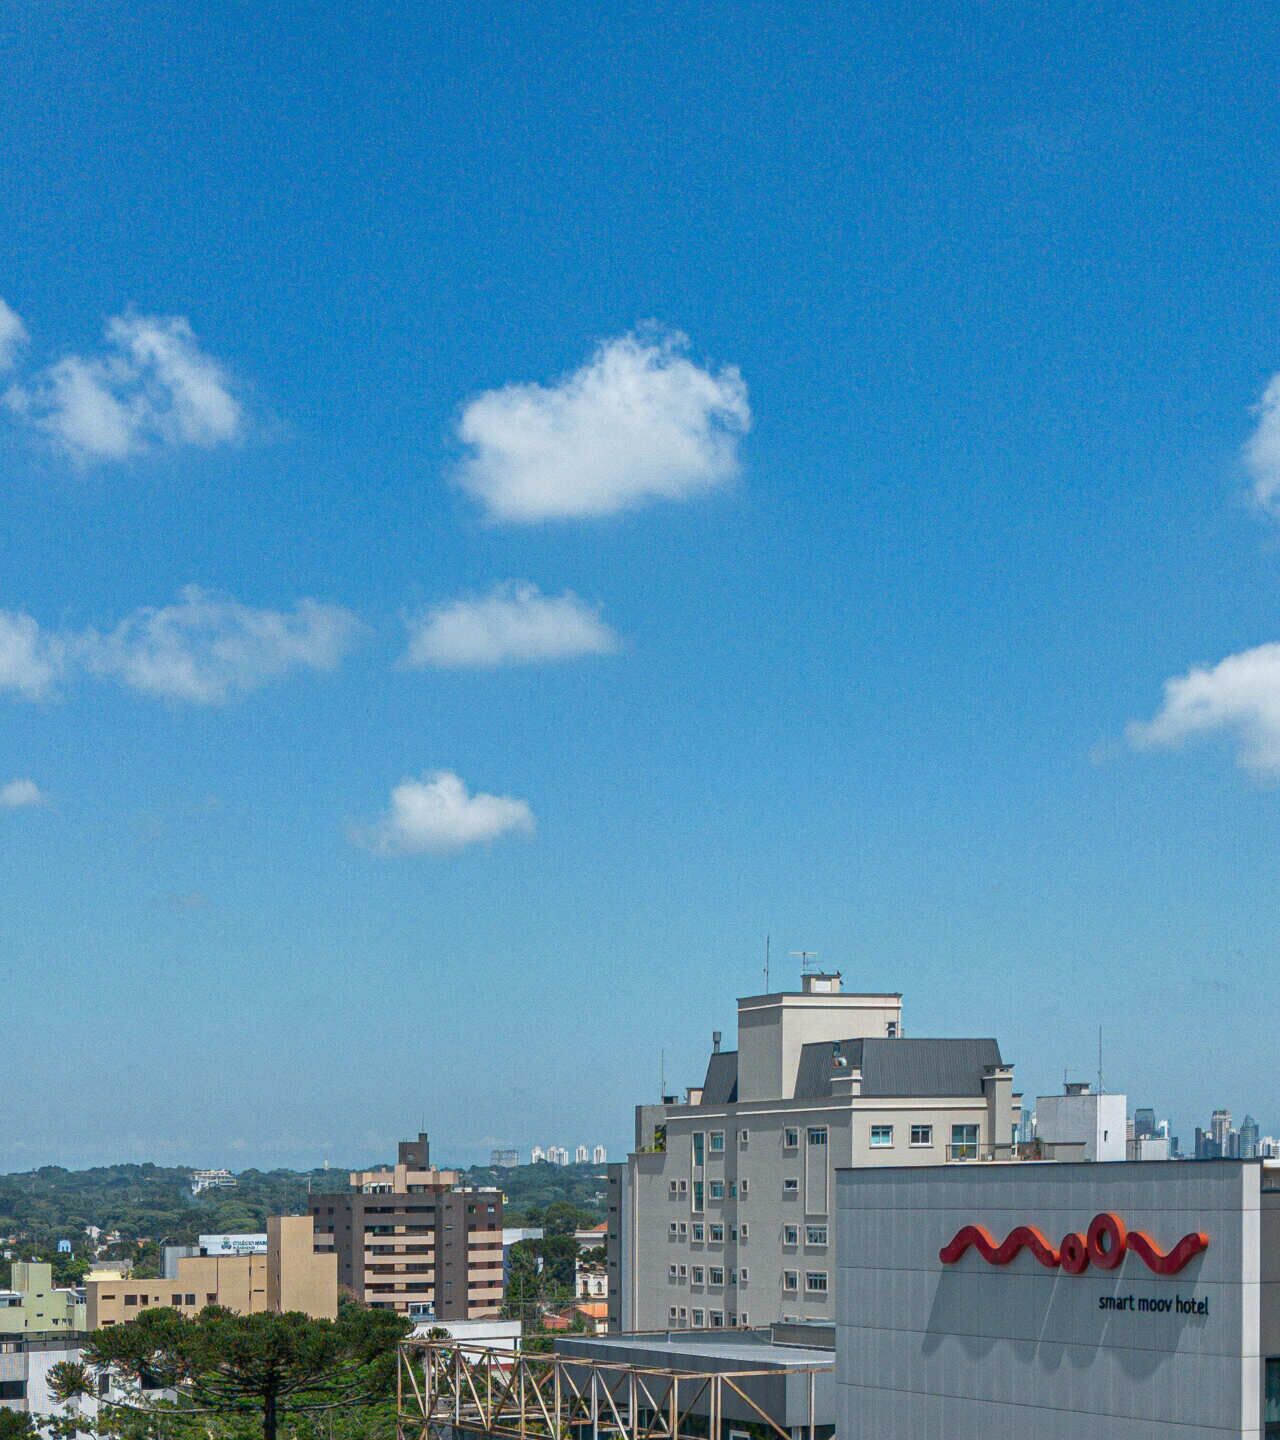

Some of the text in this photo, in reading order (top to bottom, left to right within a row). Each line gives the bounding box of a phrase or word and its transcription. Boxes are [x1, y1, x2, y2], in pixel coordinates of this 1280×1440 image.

[1098, 1294, 1209, 1316] smart moov hotel
